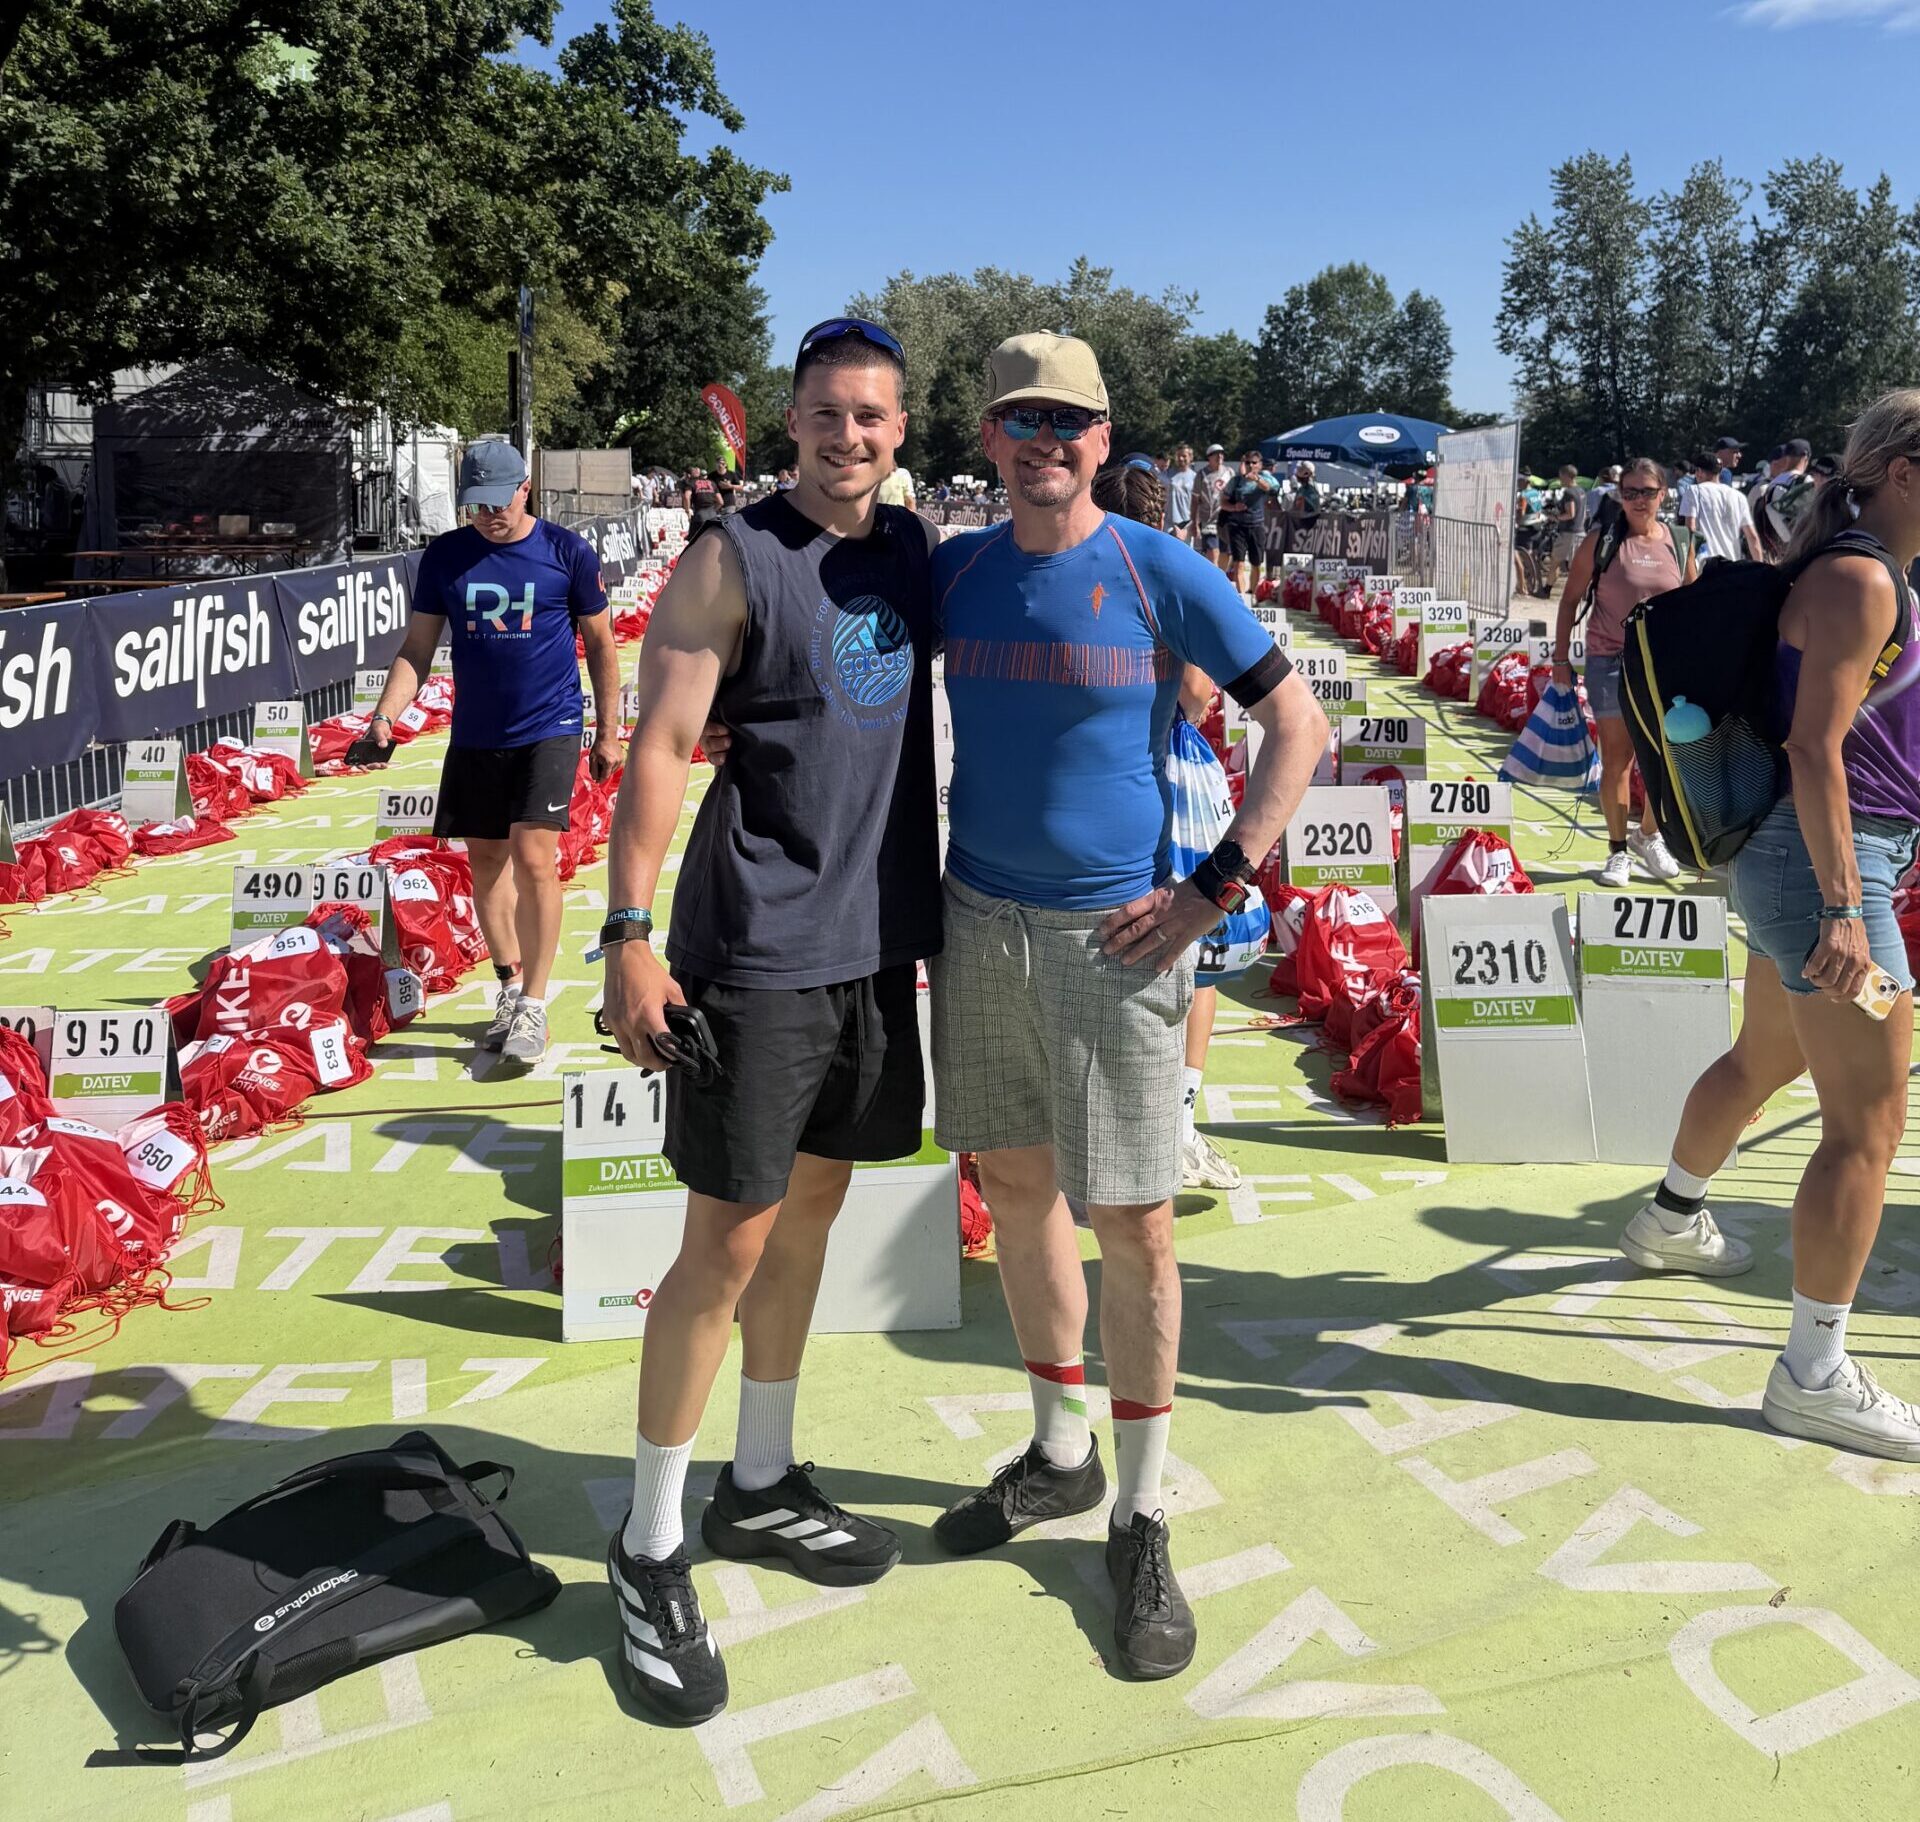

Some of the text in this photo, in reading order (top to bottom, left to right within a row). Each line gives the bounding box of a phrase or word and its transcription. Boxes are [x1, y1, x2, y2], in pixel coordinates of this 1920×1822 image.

[949, 504, 987, 527] sailfish
[602, 522, 636, 575] sailfish
[298, 566, 406, 666] sailfish
[1428, 606, 1462, 621] 3290
[1483, 626, 1522, 644] 3280
[115, 590, 271, 710] sailfish
[0, 621, 72, 730] sh
[1295, 658, 1337, 676] 2810
[366, 674, 385, 687] 60
[1312, 679, 1353, 701] 2800
[267, 705, 289, 721] 50
[1360, 718, 1409, 744] 2790
[141, 746, 165, 763] 40
[1365, 749, 1402, 759] DATEV
[386, 795, 434, 816] 500
[1213, 797, 1232, 821] 14
[1430, 783, 1491, 814] 2780
[392, 827, 421, 836] DATEV
[1303, 822, 1373, 856] 2320
[1318, 867, 1364, 880] DATEV
[243, 871, 302, 899] 490
[402, 878, 429, 891] 962
[253, 913, 288, 925] DATEV
[1614, 897, 1698, 942] 2770
[276, 935, 306, 952] 951
[1451, 939, 1547, 985] 2310
[1620, 950, 1685, 967] DATEV
[398, 975, 412, 1005] 958
[1473, 999, 1536, 1017] DATEV
[66, 1018, 153, 1057] 950
[322, 1038, 339, 1070] 953
[82, 1075, 132, 1089] DATEV
[138, 1143, 173, 1172] 950
[601, 1158, 673, 1182] DATEV
[588, 1183, 614, 1192] Zukunft
[648, 1180, 682, 1189] Gemeins
[603, 1296, 633, 1306] DATEV
